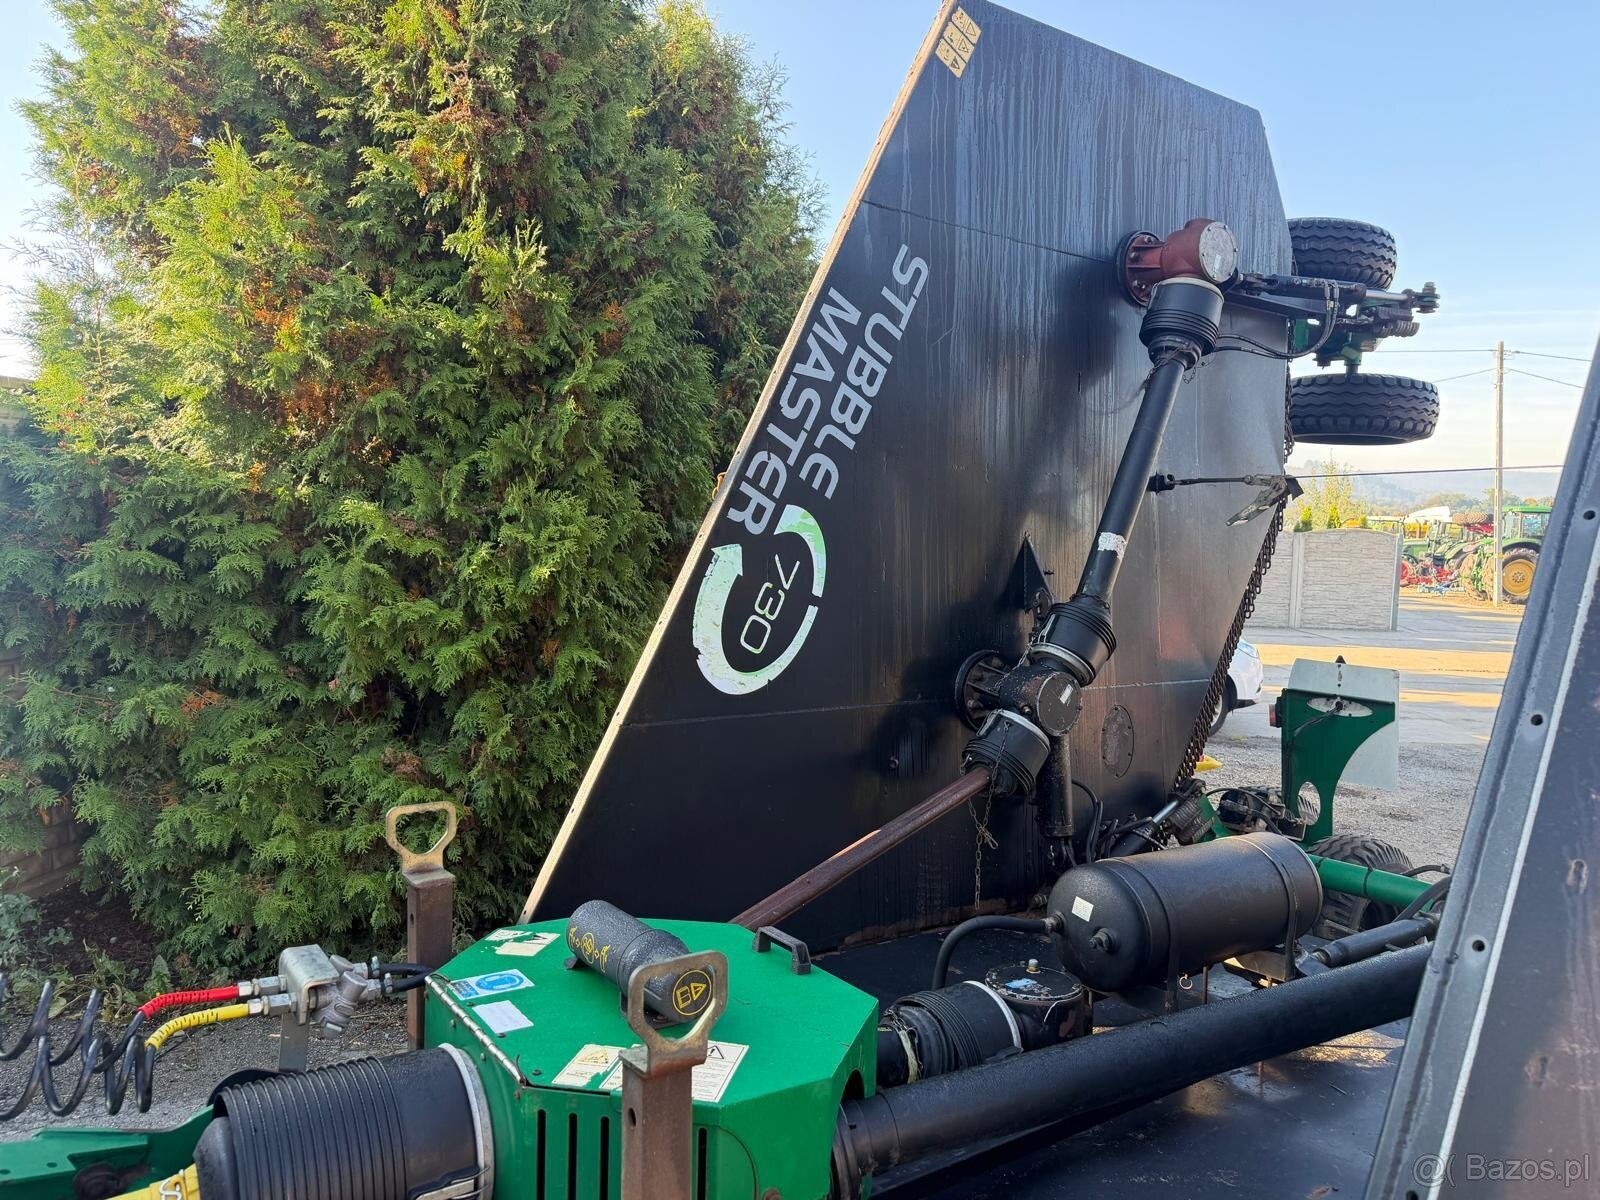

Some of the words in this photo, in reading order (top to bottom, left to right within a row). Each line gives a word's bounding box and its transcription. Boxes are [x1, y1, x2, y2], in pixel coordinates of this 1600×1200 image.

[727, 287, 862, 535] MASTER
[800, 244, 929, 500] STUBBLE
[740, 553, 800, 655] 730
